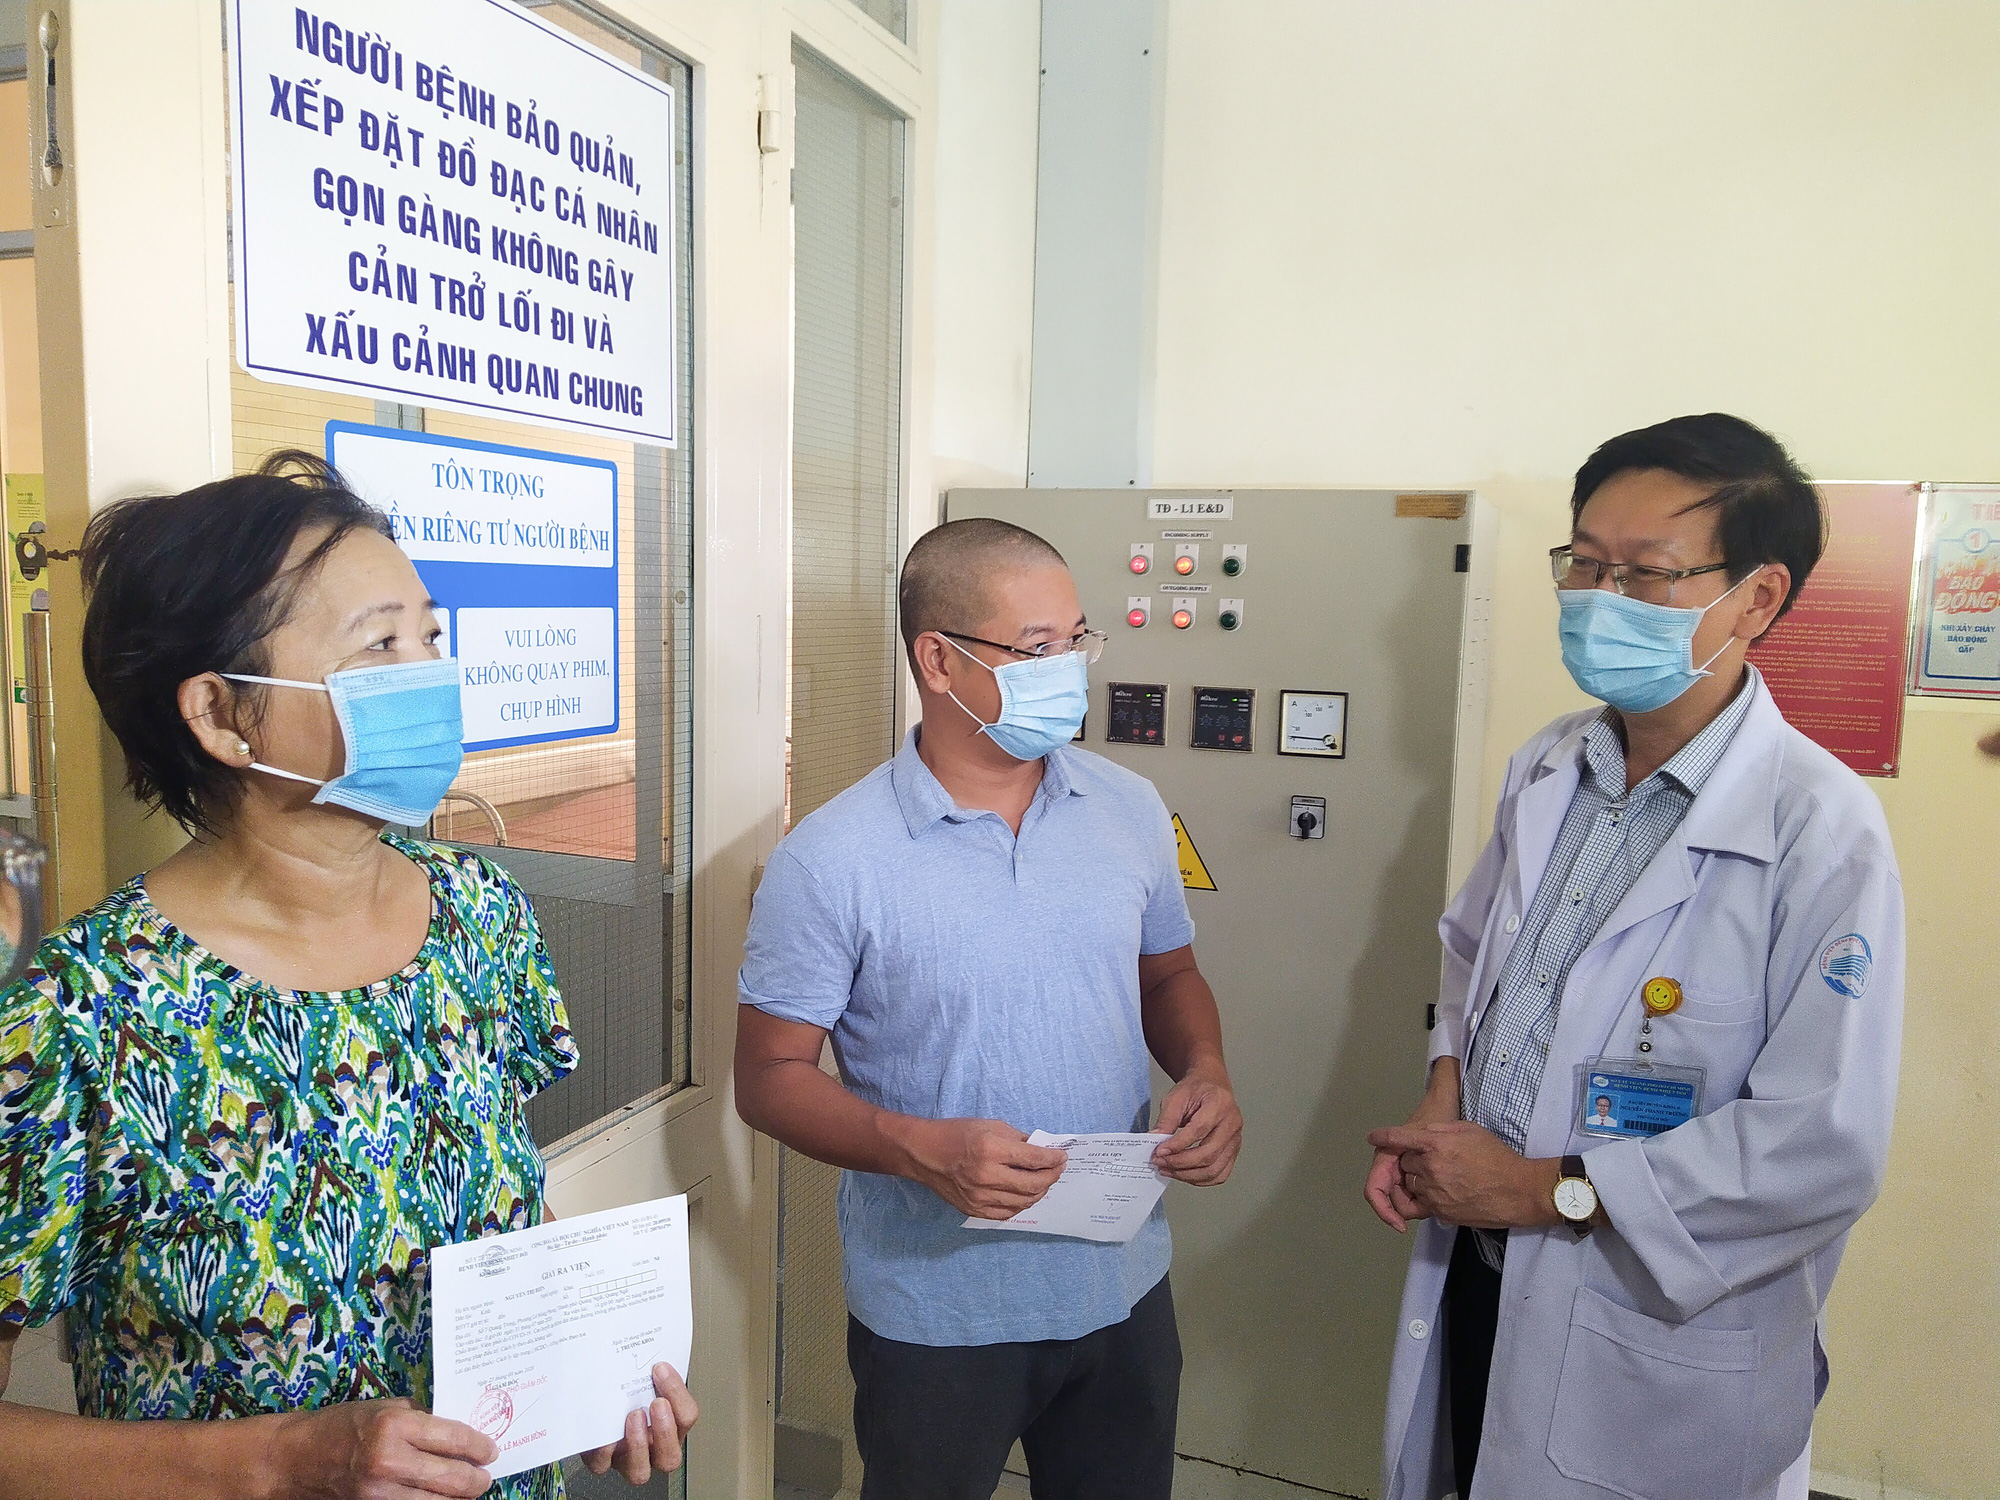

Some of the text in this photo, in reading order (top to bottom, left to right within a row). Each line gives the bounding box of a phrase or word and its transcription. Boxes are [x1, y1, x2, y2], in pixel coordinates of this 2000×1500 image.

[295, 7, 642, 196] NGƯỜI BỆNH BẢO QUẢN,
[269, 73, 658, 255] XẾP ĐẶT ĐỒ ĐẠC CÁ NHÂN
[313, 167, 634, 302] GỌN GÀNG KHÔNG GÂY
[348, 244, 614, 354] CẢN TRỞ LỐI ĐI VÀ
[305, 309, 643, 416] XẤU CẢNH QUAN CHUNG
[431, 458, 545, 500] TÔN TRỌNG
[1155, 504, 1171, 513] TĐ
[1181, 504, 1194, 513] L1
[1197, 504, 1224, 513] E&D
[422, 511, 481, 545] RIÊNG
[486, 518, 511, 546] TƯ
[514, 515, 566, 549] NGƯỜI
[568, 522, 610, 554] BỆNH
[1970, 532, 1981, 549] 1
[504, 624, 576, 648] VUI LÒNG
[464, 659, 610, 686] KHÔNG QUAY PHIM,
[500, 695, 581, 723] CHỤP HÌNH
